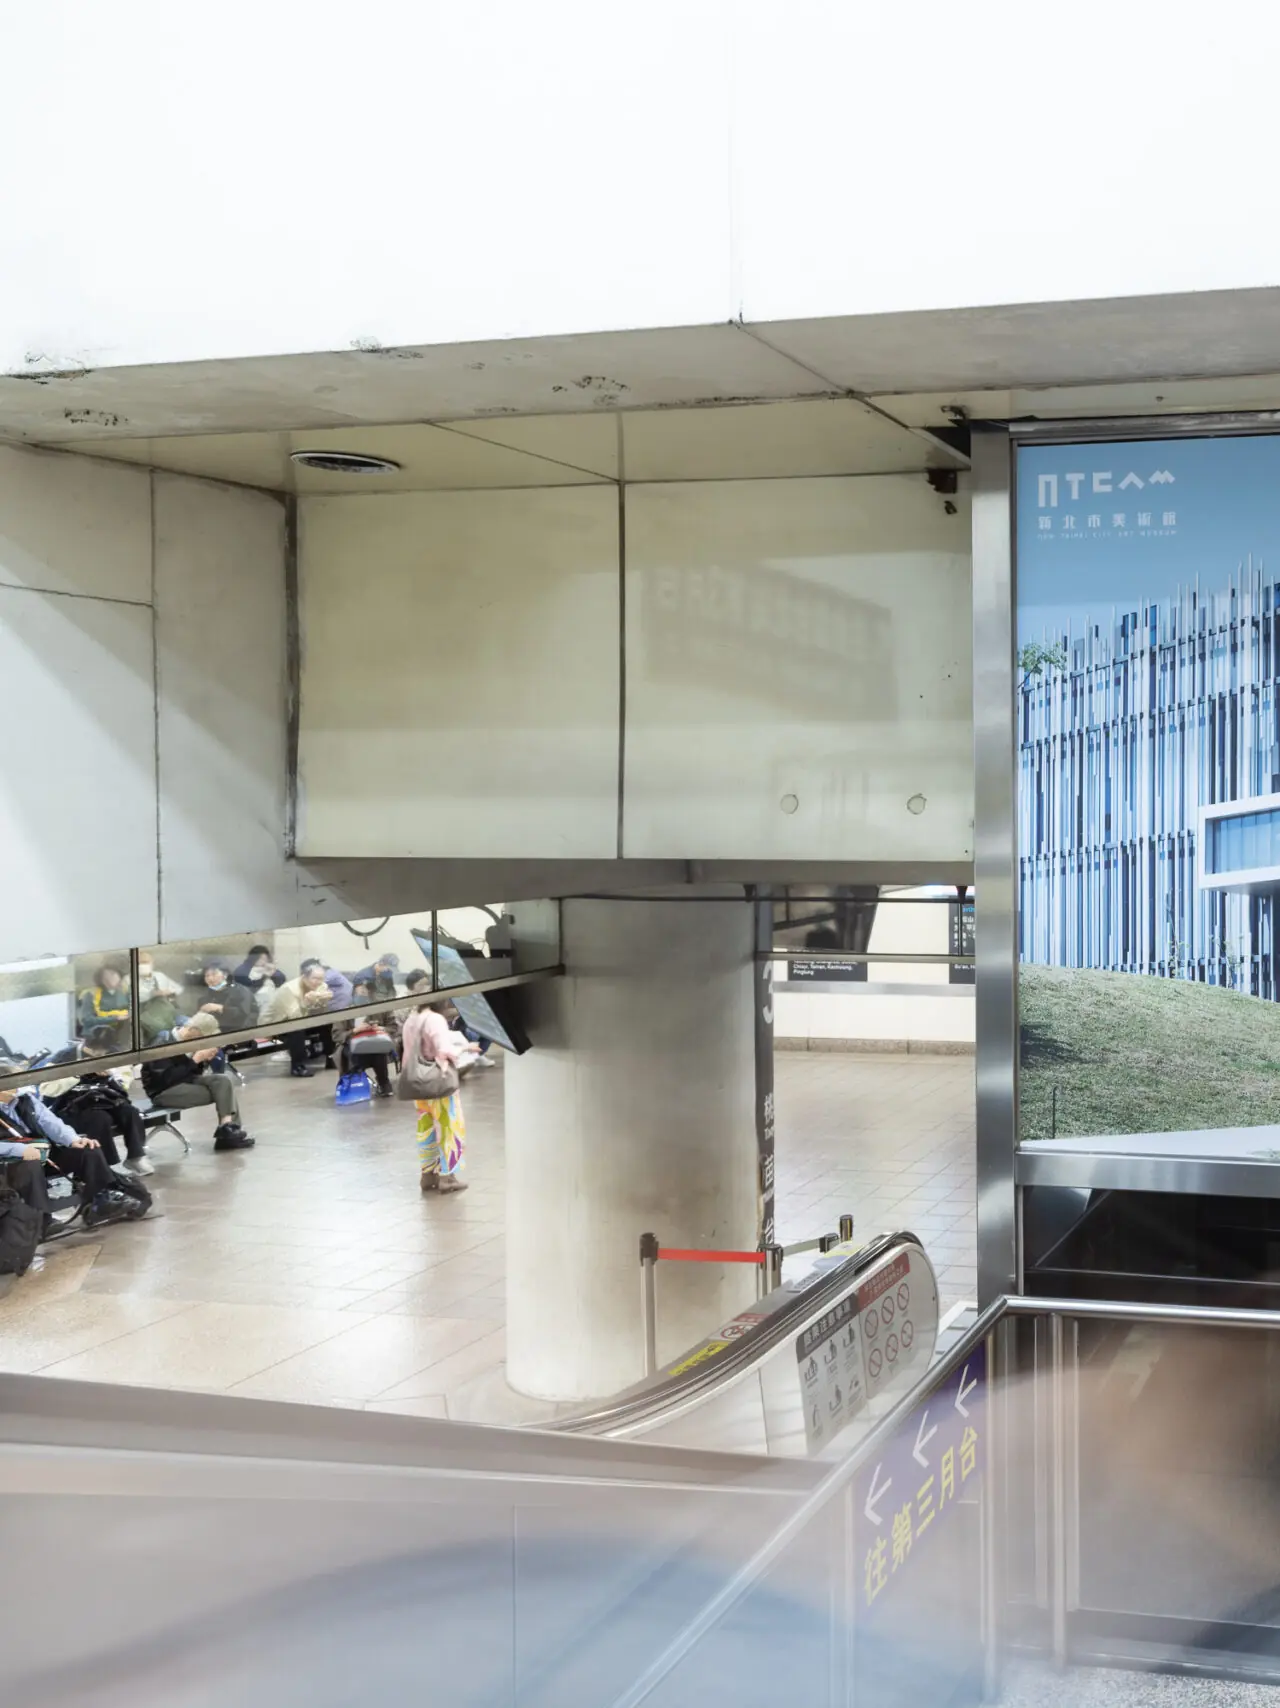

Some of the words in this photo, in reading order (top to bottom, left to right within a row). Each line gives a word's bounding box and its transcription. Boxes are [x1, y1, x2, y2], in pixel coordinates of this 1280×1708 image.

[863, 1425, 979, 1607] 往第三月台
